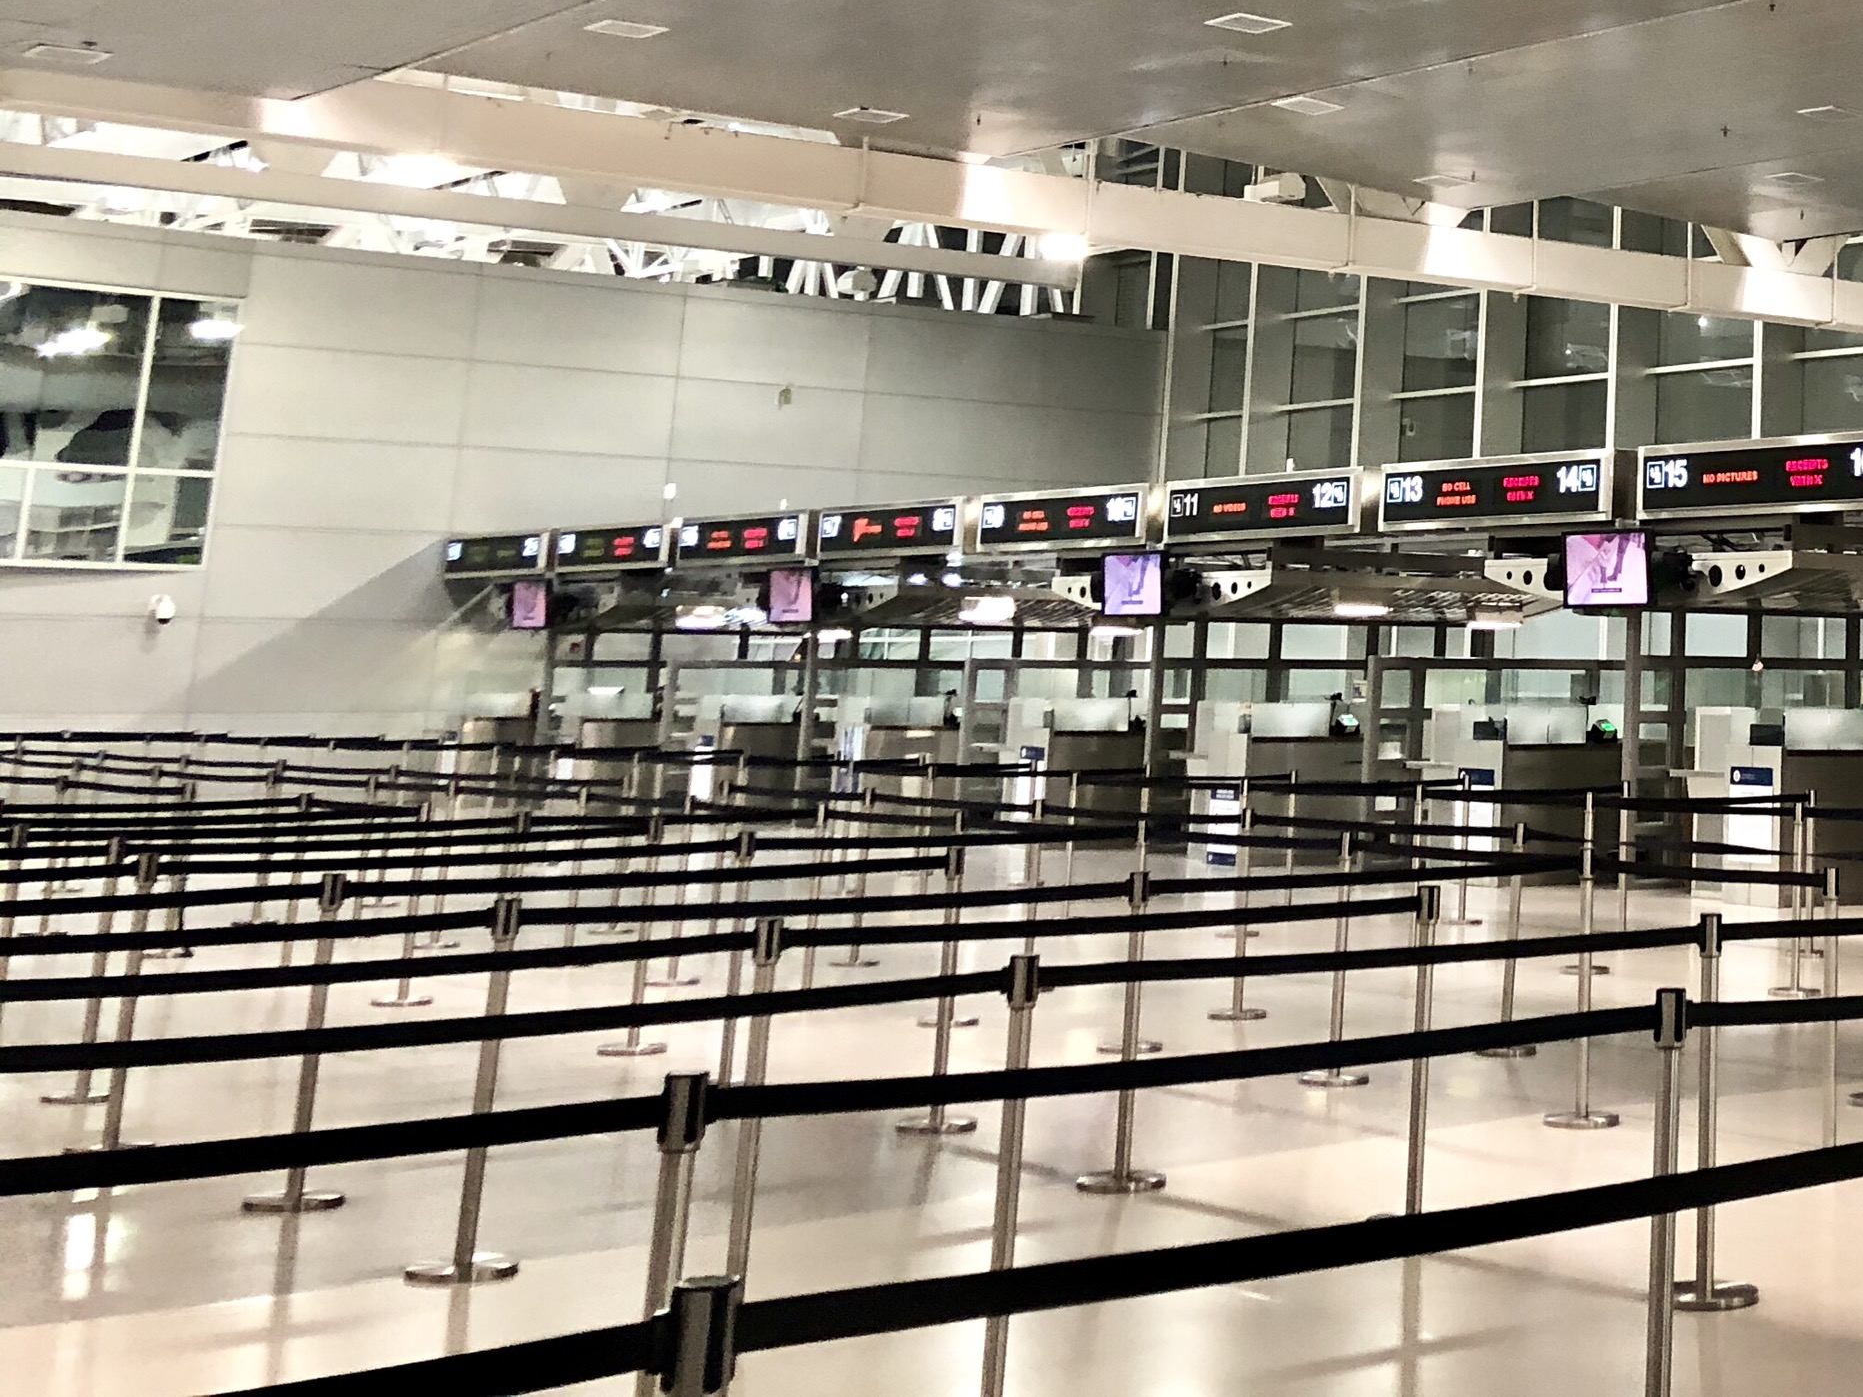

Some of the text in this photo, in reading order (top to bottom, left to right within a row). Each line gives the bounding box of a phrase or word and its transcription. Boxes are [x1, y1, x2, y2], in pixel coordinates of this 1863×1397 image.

[1557, 465, 1579, 493] 14
[1665, 459, 1688, 487] 15
[1703, 471, 1758, 483] NO PICTURES
[1312, 482, 1332, 508] 12
[1402, 476, 1423, 502] 13
[1185, 493, 1199, 516] 11
